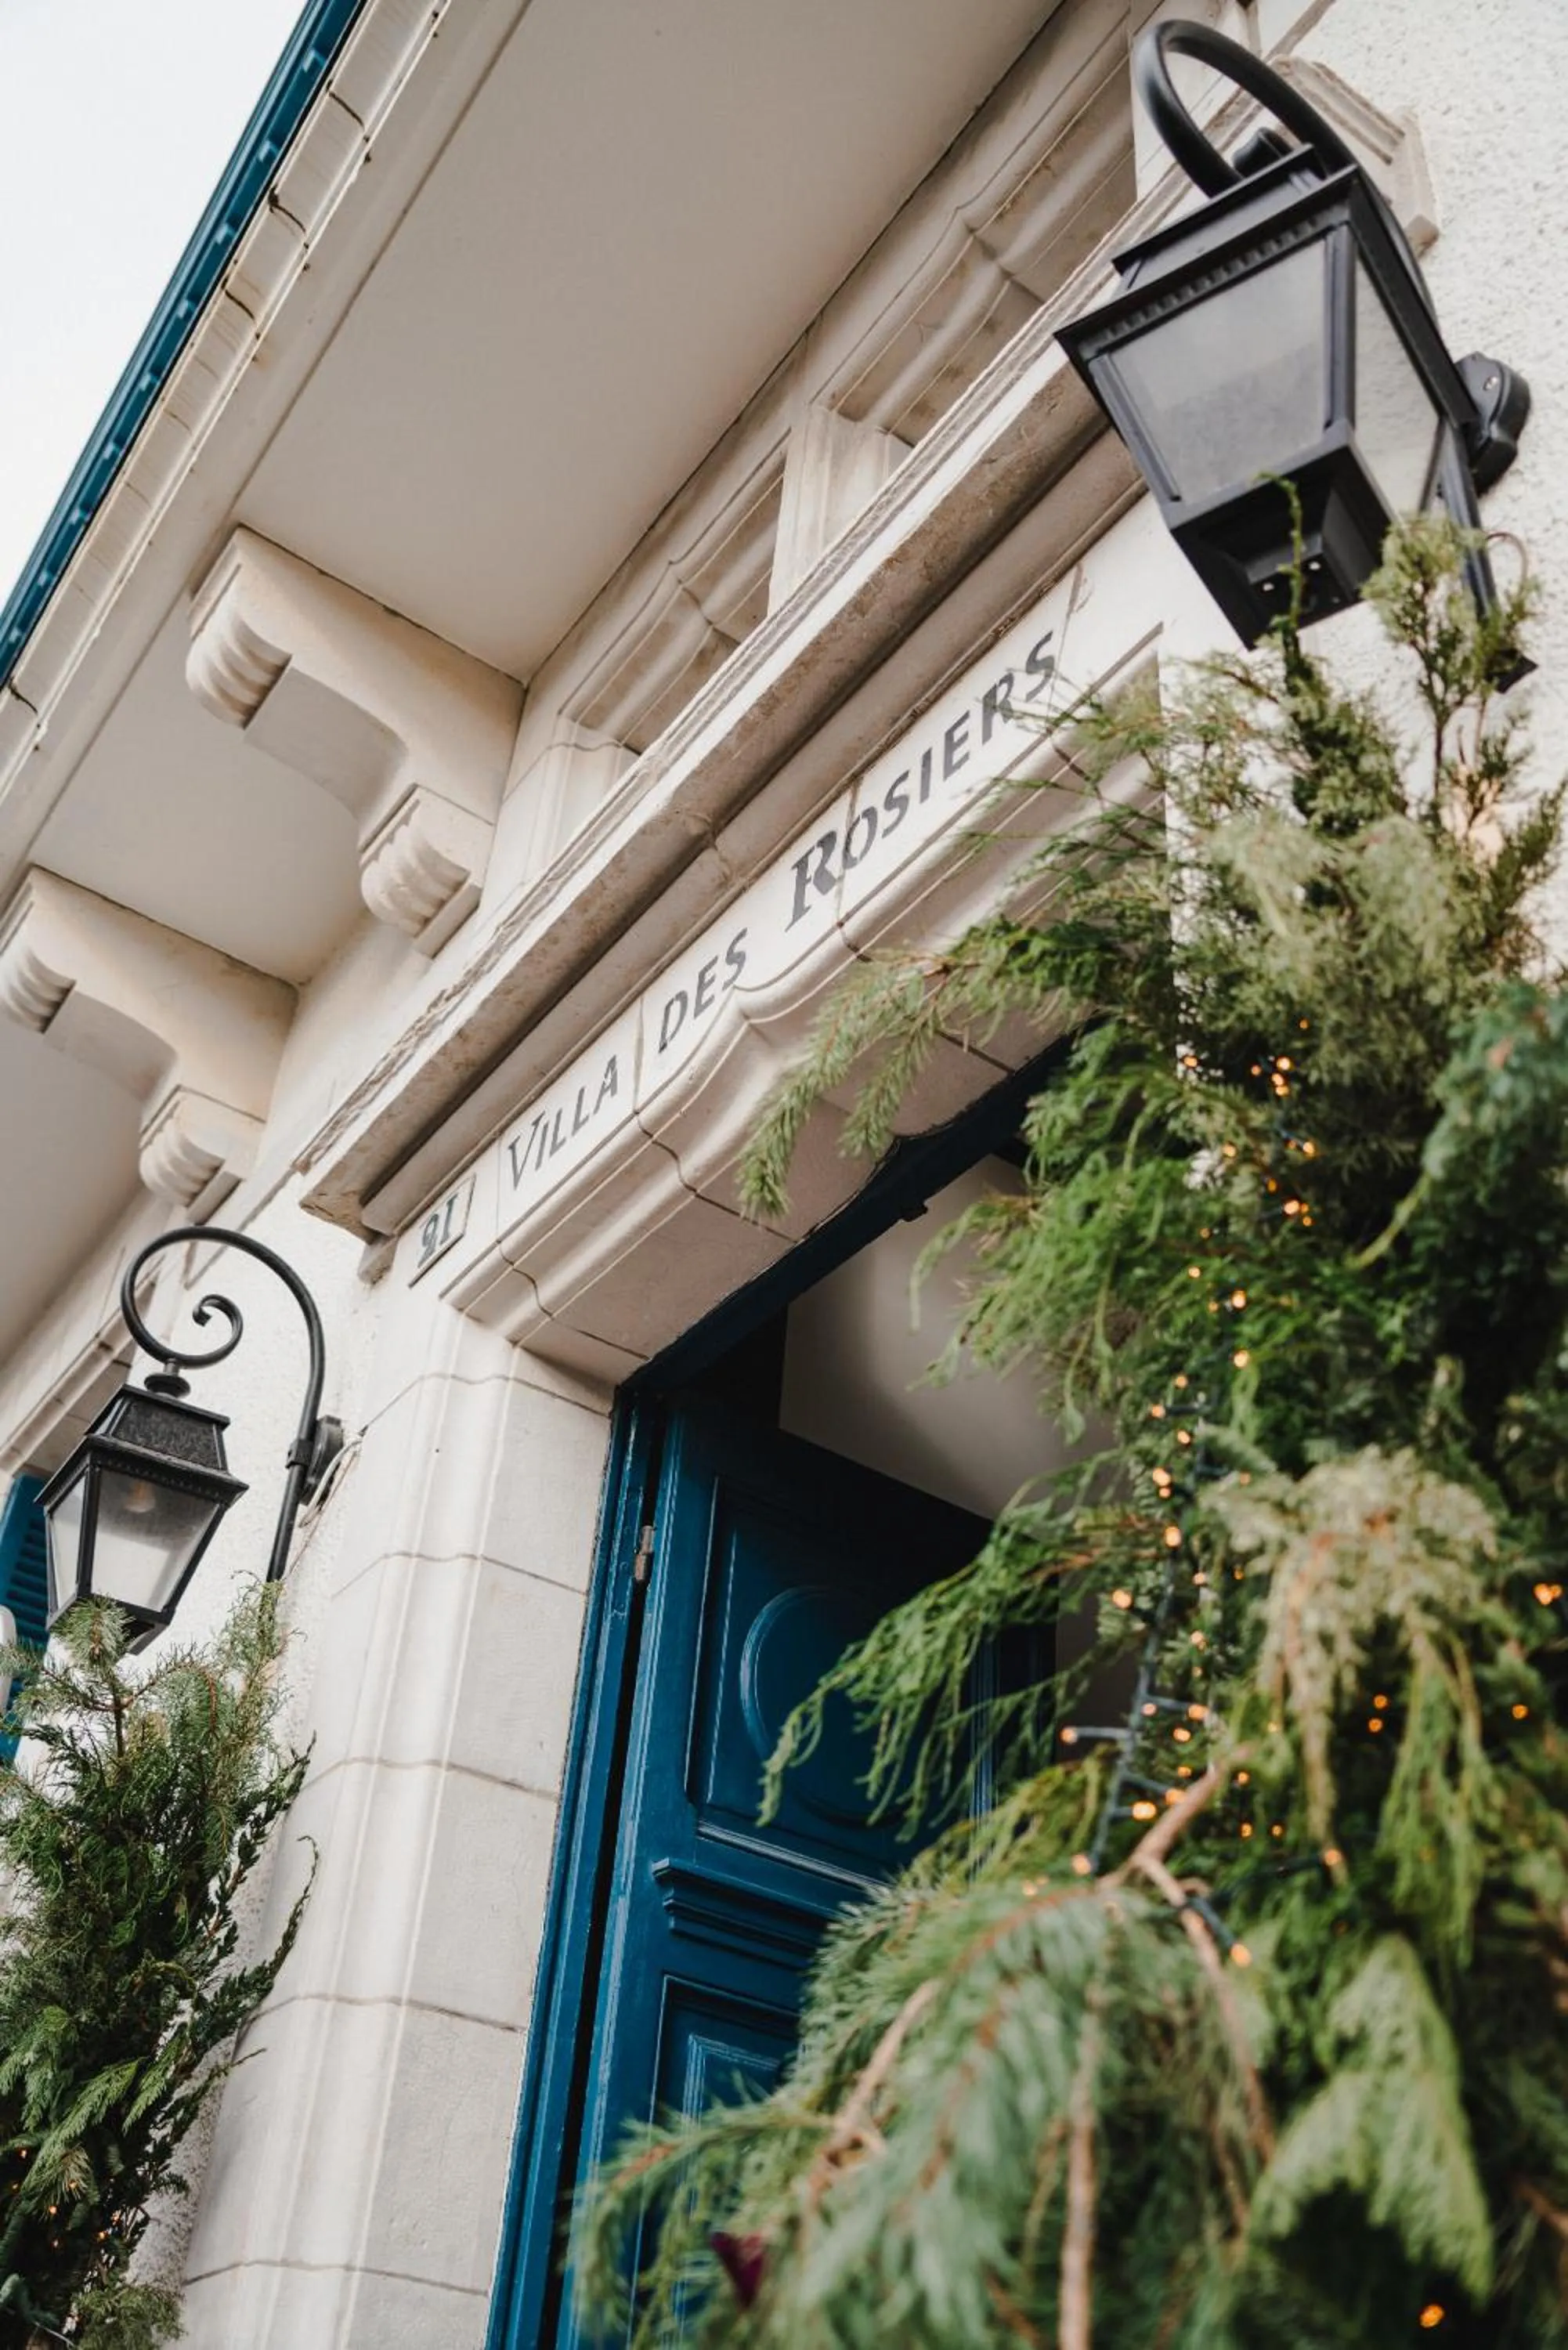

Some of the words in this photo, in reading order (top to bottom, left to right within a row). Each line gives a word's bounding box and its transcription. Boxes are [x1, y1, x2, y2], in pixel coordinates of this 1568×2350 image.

[508, 1054, 619, 1191] VILLA
[658, 927, 749, 1054] DES
[785, 631, 1055, 932] ROSIERS
